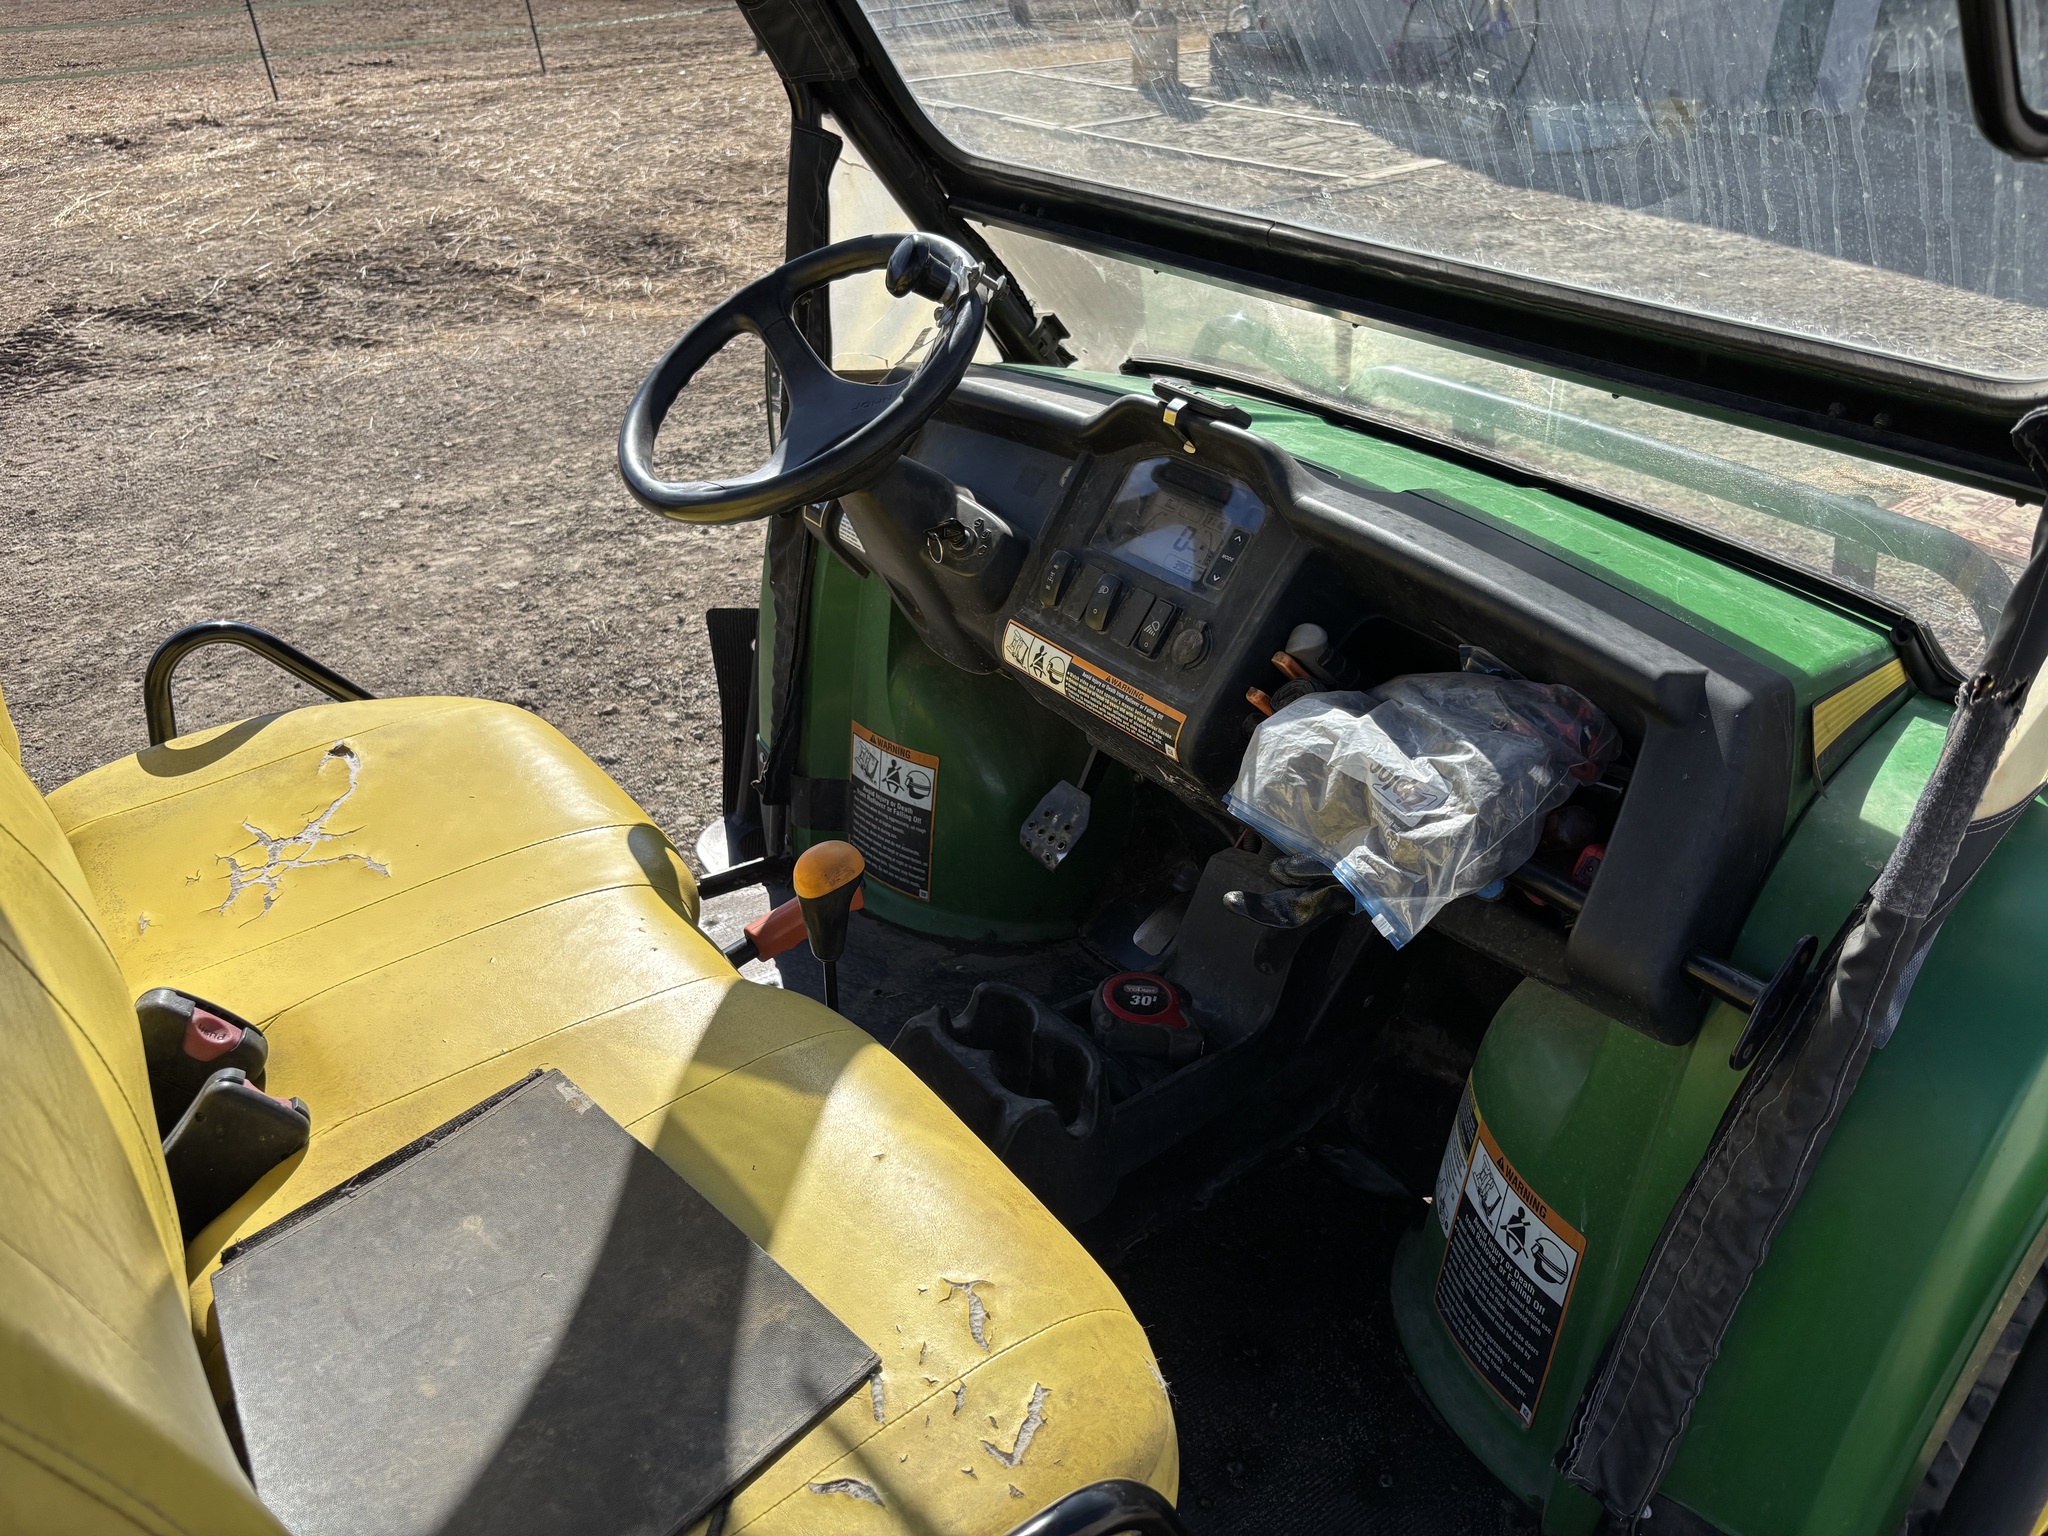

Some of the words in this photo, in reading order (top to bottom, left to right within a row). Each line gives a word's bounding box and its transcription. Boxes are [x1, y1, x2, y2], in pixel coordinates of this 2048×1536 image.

[851, 395, 892, 411] JOHN
[1221, 553, 1235, 563] MODE
[1081, 671, 1092, 681] Avoid
[1091, 677, 1101, 687] Injury
[1105, 684, 1116, 694] Death
[1116, 690, 1124, 699] from
[1124, 695, 1140, 707] Rollover
[1144, 705, 1157, 718] Falling
[1111, 677, 1145, 701] WARNING
[877, 738, 911, 759] WARNING
[856, 786, 866, 798] from
[866, 794, 886, 810] Rollover
[886, 805, 892, 813] or
[892, 808, 911, 821] Falling
[912, 815, 921, 823] Off
[862, 784, 874, 797] Avoid
[875, 792, 888, 805] Injury
[889, 800, 896, 808] or
[896, 803, 913, 814] Death
[1129, 994, 1158, 1006] 30'
[1504, 1166, 1548, 1218] WARNING
[1464, 1212, 1476, 1236] from
[1475, 1231, 1498, 1267] Rollover
[1498, 1263, 1506, 1277] or
[1506, 1272, 1532, 1304] Falling
[1532, 1298, 1545, 1316] Off
[1473, 1215, 1487, 1241] Avoid
[1486, 1236, 1505, 1265] Injury
[1505, 1260, 1513, 1273] or
[1513, 1268, 1535, 1295] Death
[1458, 1218, 1466, 1236] Watch
[1466, 1232, 1474, 1249] video
[1480, 1254, 1488, 1269] read
[1487, 1265, 1508, 1293] operator's
[1507, 1288, 1525, 1310] manual
[1524, 1306, 1541, 1325] before
[1540, 1322, 1553, 1336] use.
[1468, 1250, 1477, 1266] must
[1476, 1262, 1482, 1272] be
[1481, 1268, 1490, 1283] able
[1489, 1279, 1494, 1289] to
[1493, 1285, 1506, 1303] grasp
[1505, 1298, 1530, 1326] handholds
[1529, 1322, 1541, 1337] with
[1462, 1299, 1472, 1317] when
[1471, 1313, 1484, 1334] driving
[1483, 1330, 1512, 1366] aggressively,
[1512, 1362, 1519, 1372] on
[1518, 1368, 1535, 1388] rough
